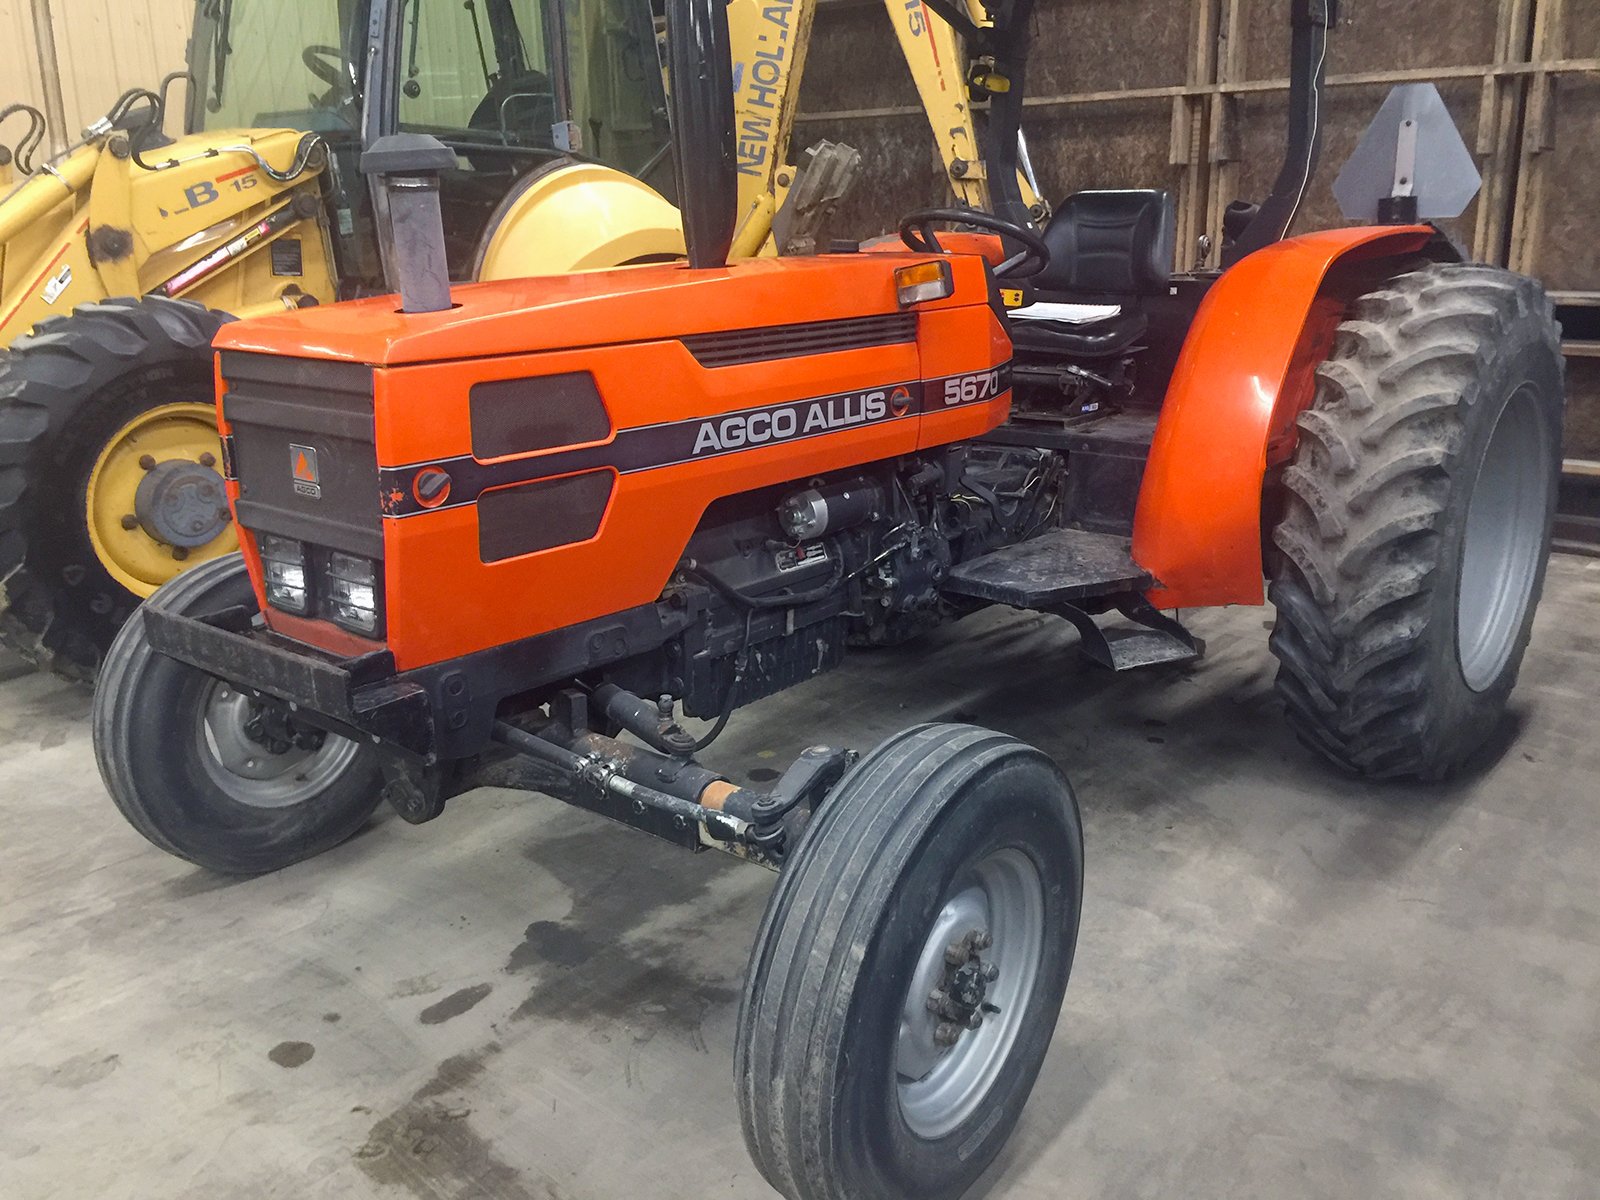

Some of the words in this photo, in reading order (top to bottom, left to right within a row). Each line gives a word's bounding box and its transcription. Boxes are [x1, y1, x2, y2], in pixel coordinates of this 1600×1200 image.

[944, 370, 999, 405] 5670
[692, 407, 797, 454] AGCO
[802, 391, 886, 433] ALLIS
